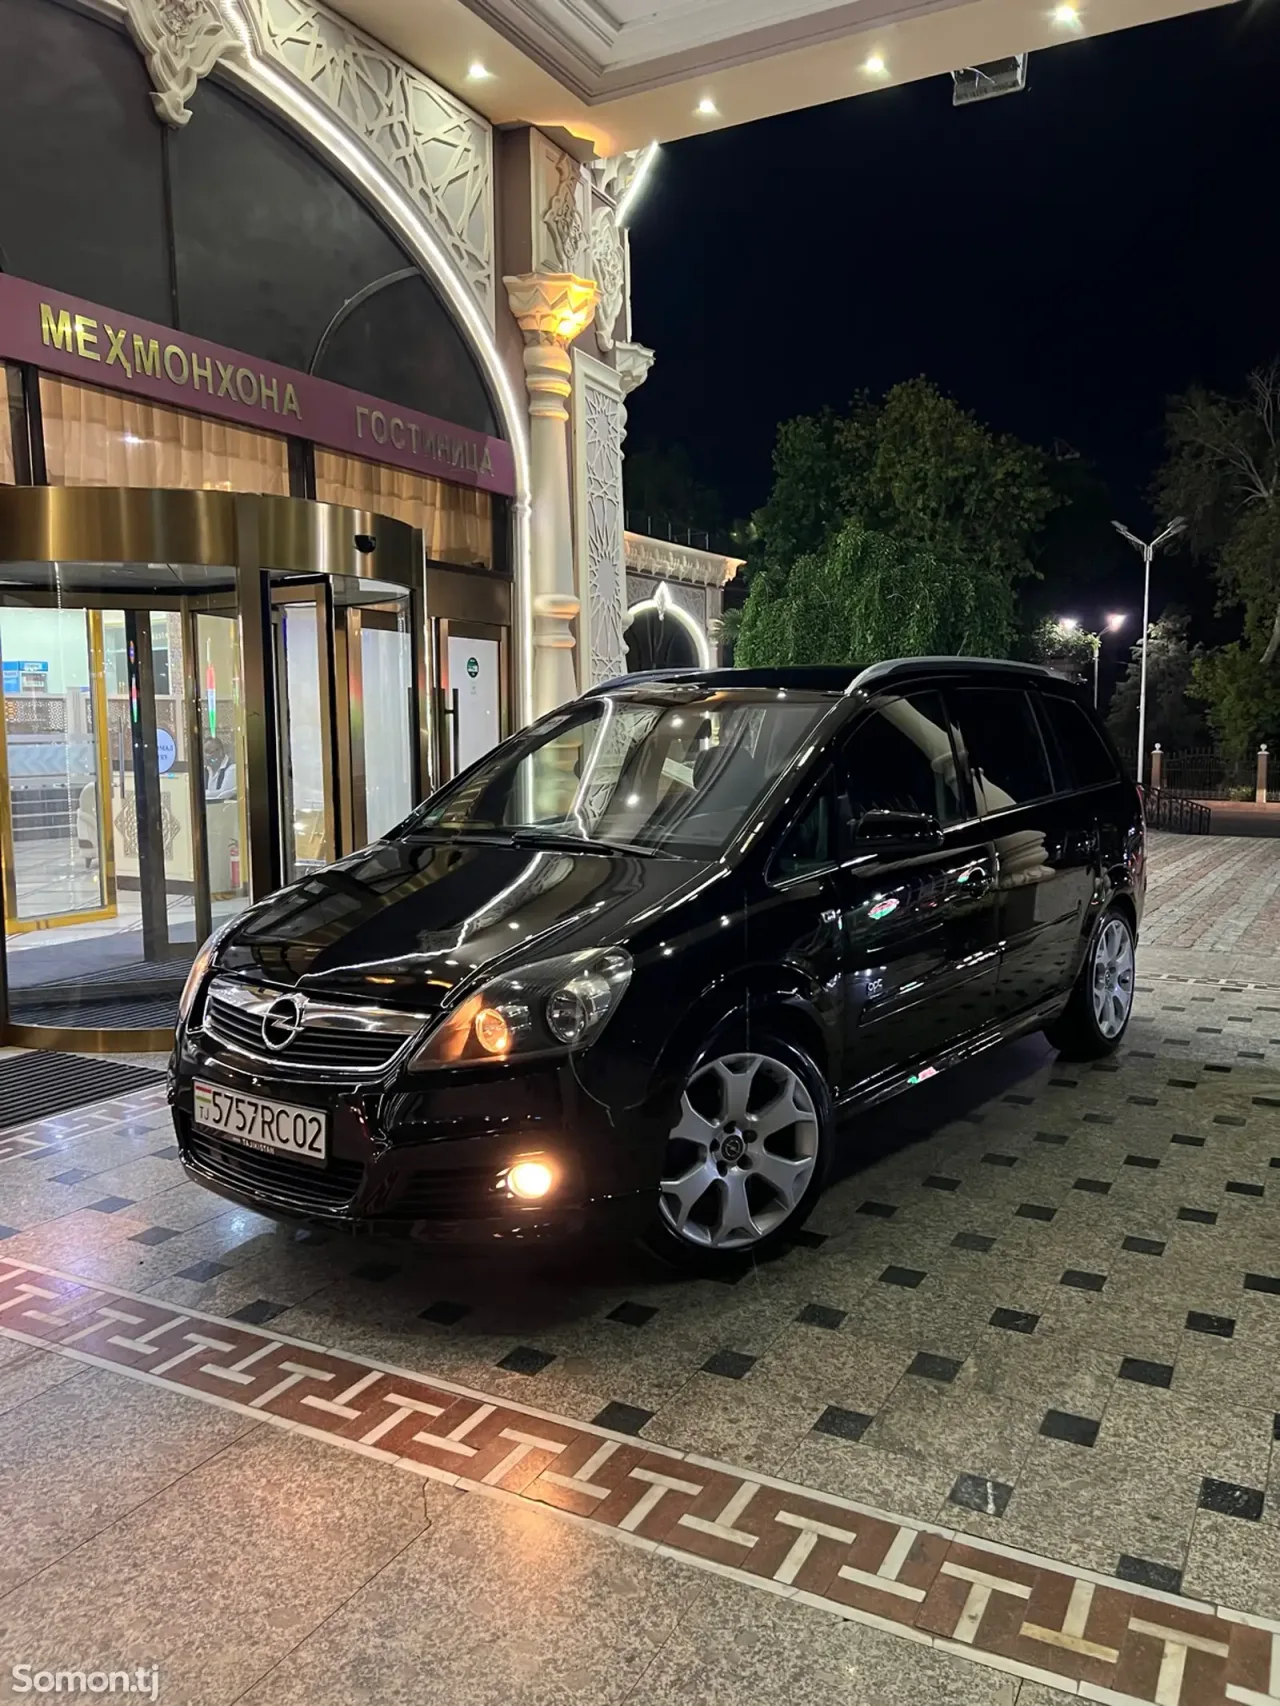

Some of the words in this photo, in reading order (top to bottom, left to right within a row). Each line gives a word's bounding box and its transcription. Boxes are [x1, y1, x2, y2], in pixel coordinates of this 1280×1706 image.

[40, 302, 303, 419] МЕҲМОНХОНА
[355, 405, 495, 477] ГОСТИНИЦА
[199, 1106, 210, 1121] TJ
